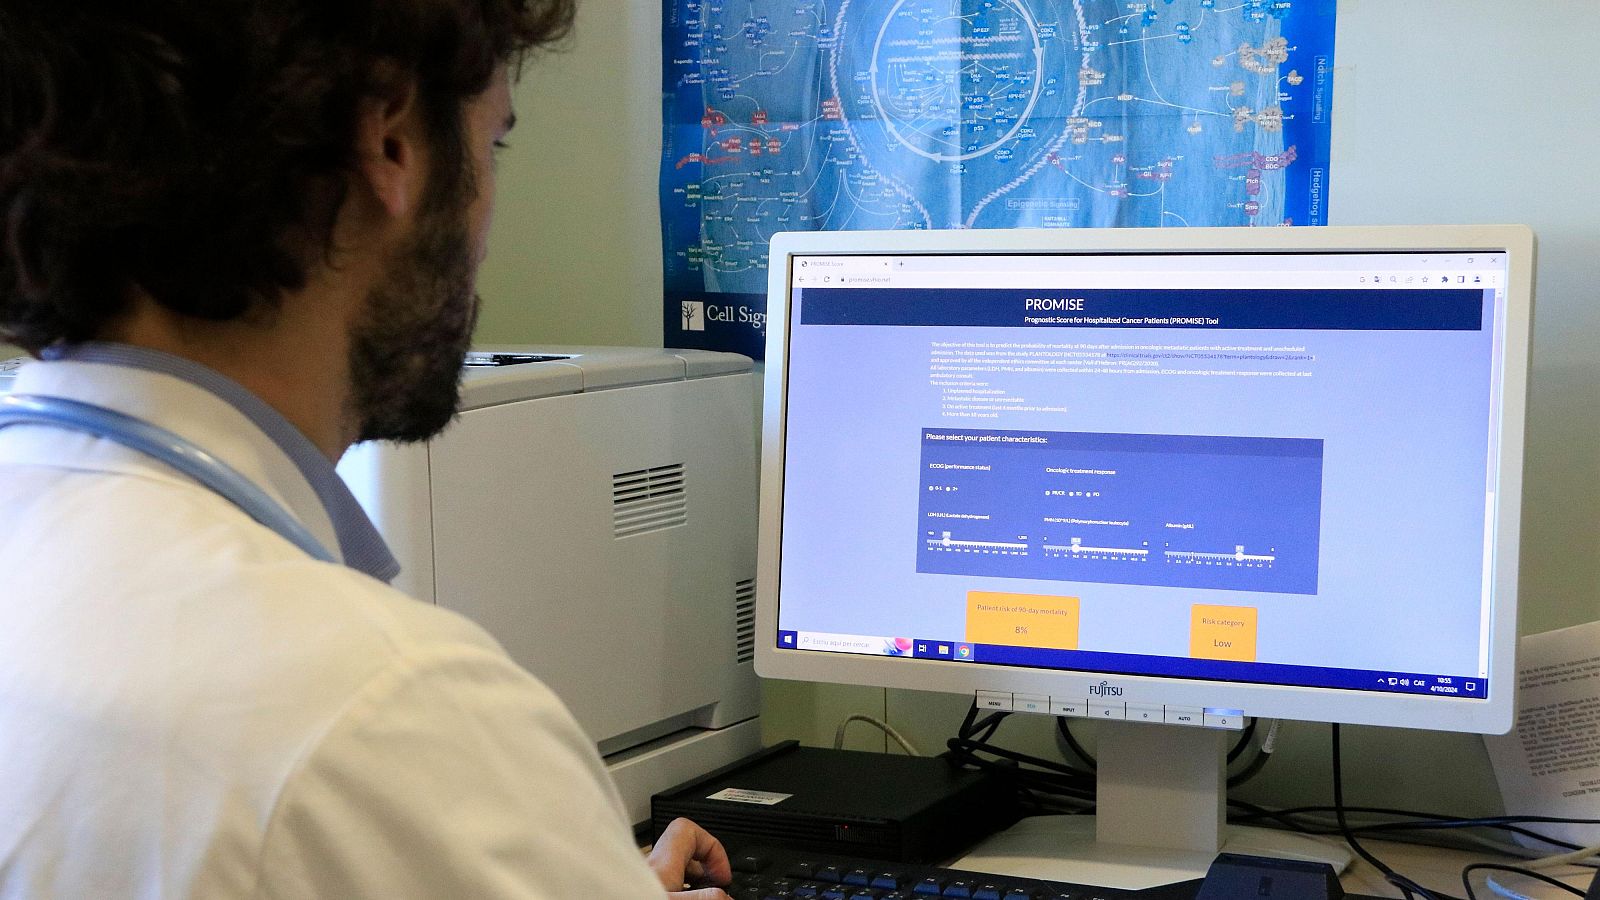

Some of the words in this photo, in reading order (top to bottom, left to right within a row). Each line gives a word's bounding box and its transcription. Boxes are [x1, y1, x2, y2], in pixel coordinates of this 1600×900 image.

[1317, 58, 1326, 84] Notch
[1310, 171, 1321, 215] Hedgehog
[1025, 298, 1084, 311] PROMISE
[707, 305, 734, 322] Cell
[1024, 316, 1056, 324] Prognostic
[1084, 317, 1120, 325] Hospitalized
[1019, 607, 1039, 615] 90-day
[1214, 639, 1232, 647] Low
[1089, 681, 1123, 697] FUJITSU
